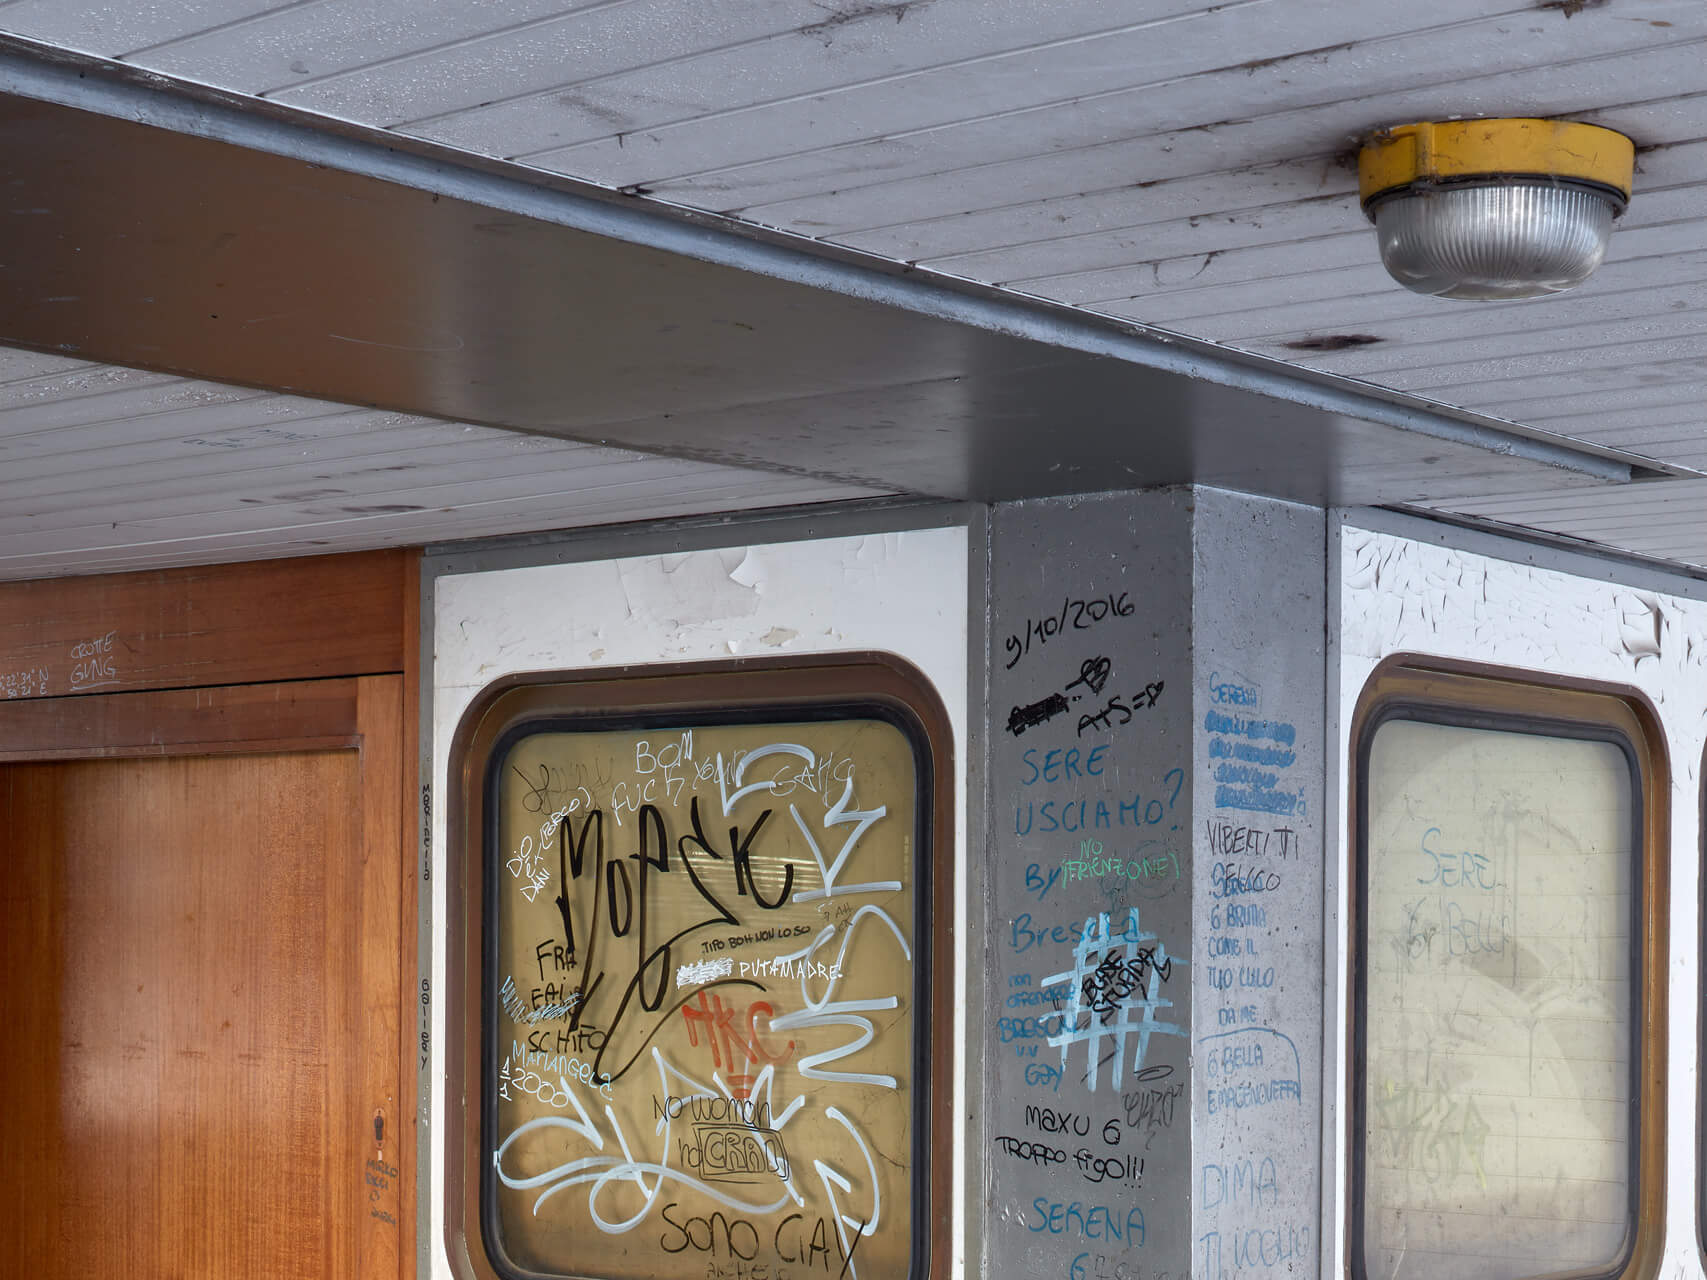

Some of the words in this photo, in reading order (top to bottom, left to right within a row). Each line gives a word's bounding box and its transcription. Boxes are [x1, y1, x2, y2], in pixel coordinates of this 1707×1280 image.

[1006, 592, 1136, 670] 9/10/2016
[1022, 745, 1111, 786] SERE
[1079, 837, 1104, 860] NO
[1025, 863, 1064, 902] By
[1210, 904, 1221, 931] 6
[727, 935, 753, 950] BOH
[754, 927, 775, 943] NON
[778, 926, 792, 939] LO
[793, 925, 812, 937] SO
[995, 1135, 1067, 1167] TROPPO
[1202, 1156, 1278, 1210] DIMA
[1028, 1197, 1146, 1248] SERENA
